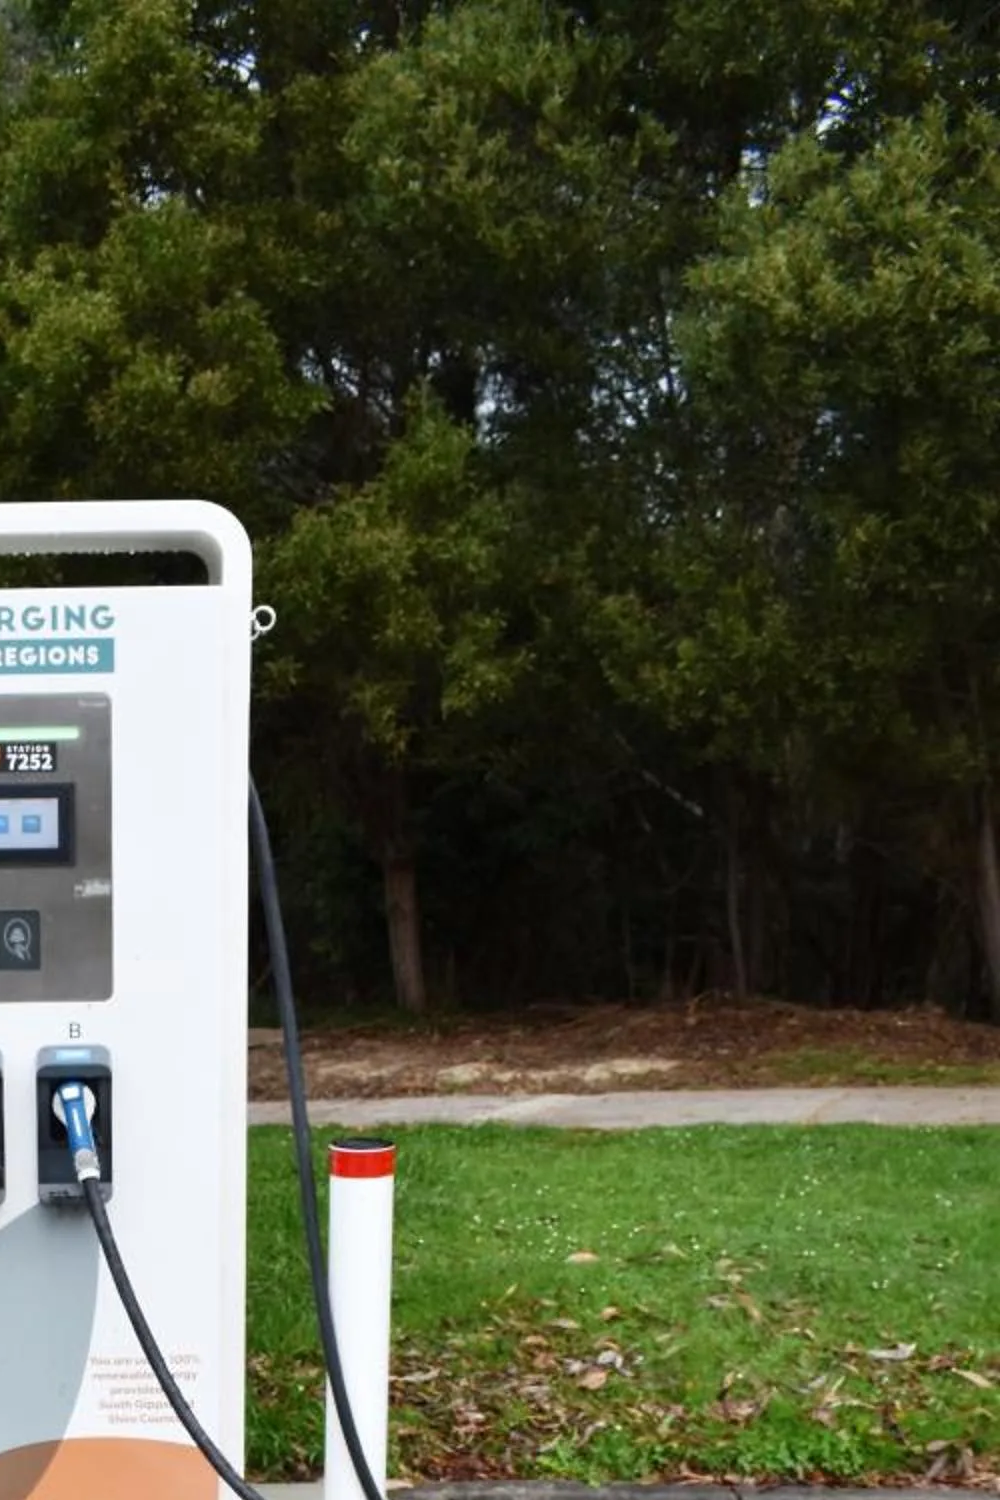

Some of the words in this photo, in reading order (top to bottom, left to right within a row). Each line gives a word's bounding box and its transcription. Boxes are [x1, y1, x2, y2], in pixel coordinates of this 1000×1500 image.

[6, 745, 50, 753] STATION
[6, 754, 53, 771] 7252
[69, 1023, 81, 1039] B
